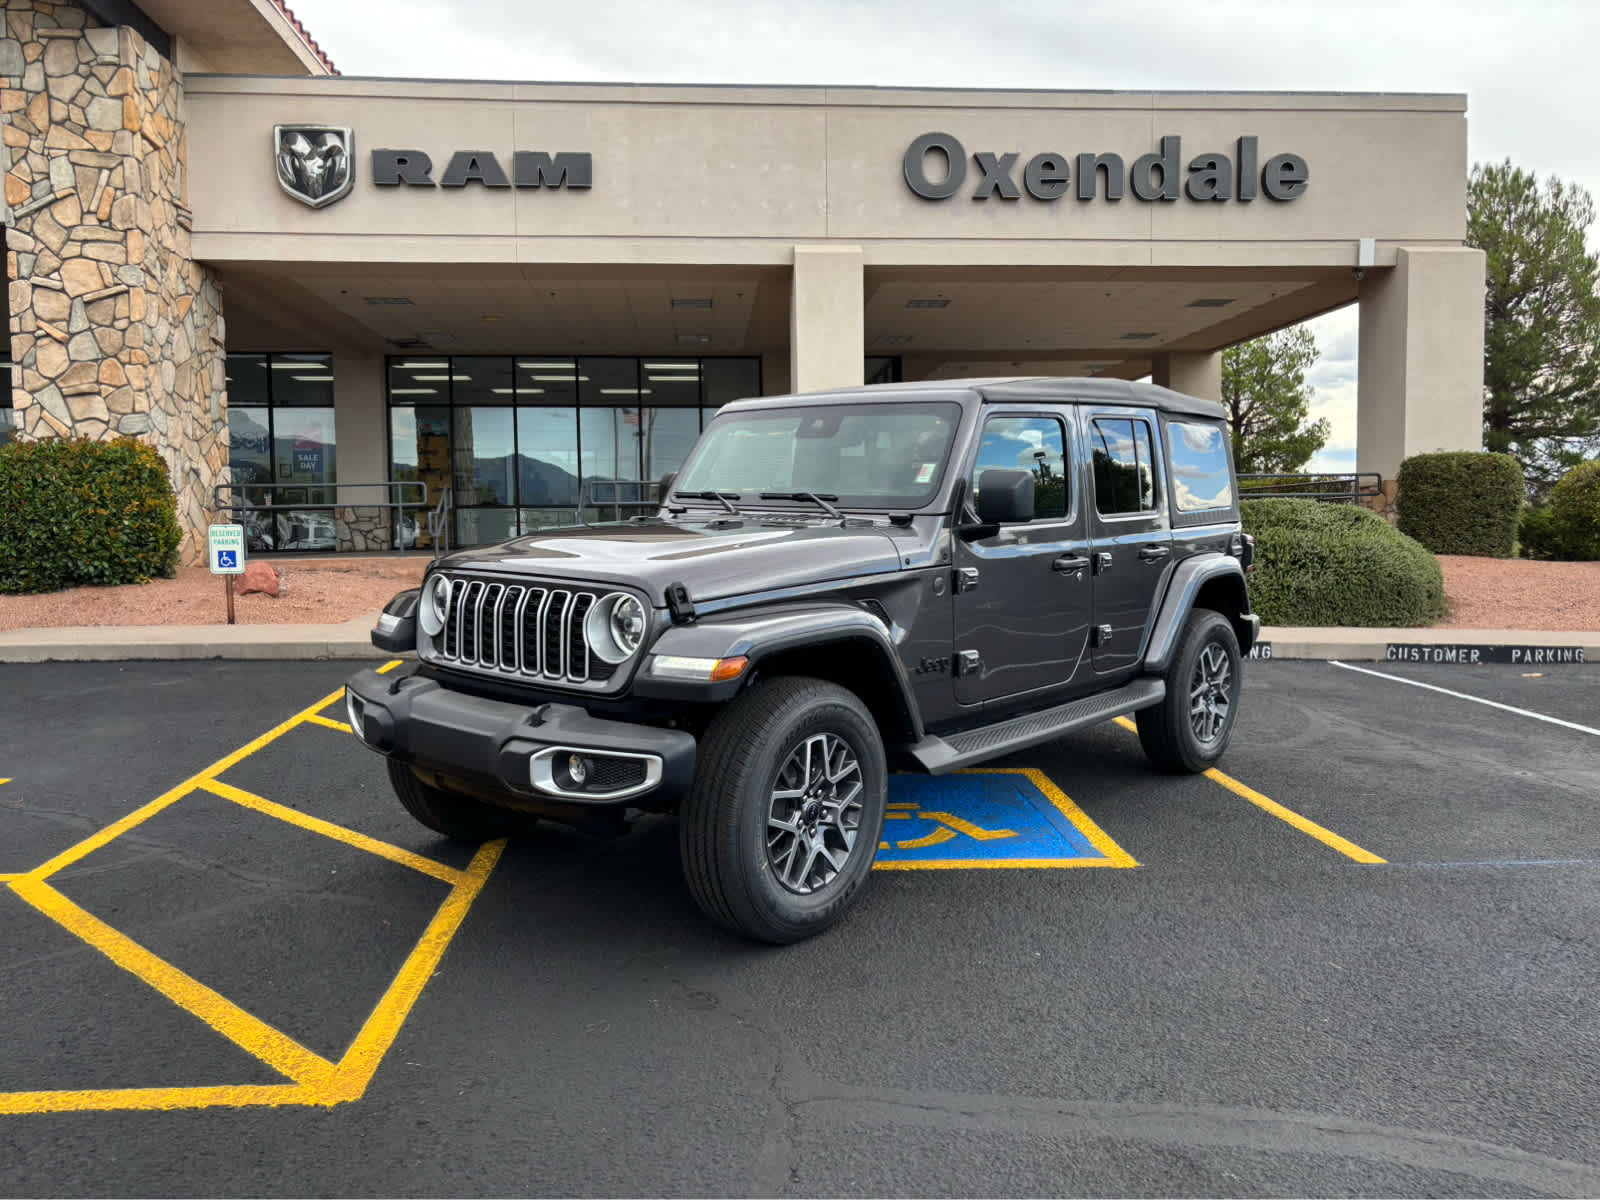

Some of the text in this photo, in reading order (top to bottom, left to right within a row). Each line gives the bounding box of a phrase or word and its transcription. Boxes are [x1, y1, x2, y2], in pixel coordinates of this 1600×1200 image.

[371, 148, 592, 189] RAM
[903, 132, 1310, 201] Oxendale
[298, 454, 320, 462] SALE
[213, 538, 240, 546] PARKING
[1386, 646, 1585, 664] CUSTOMER PARKING
